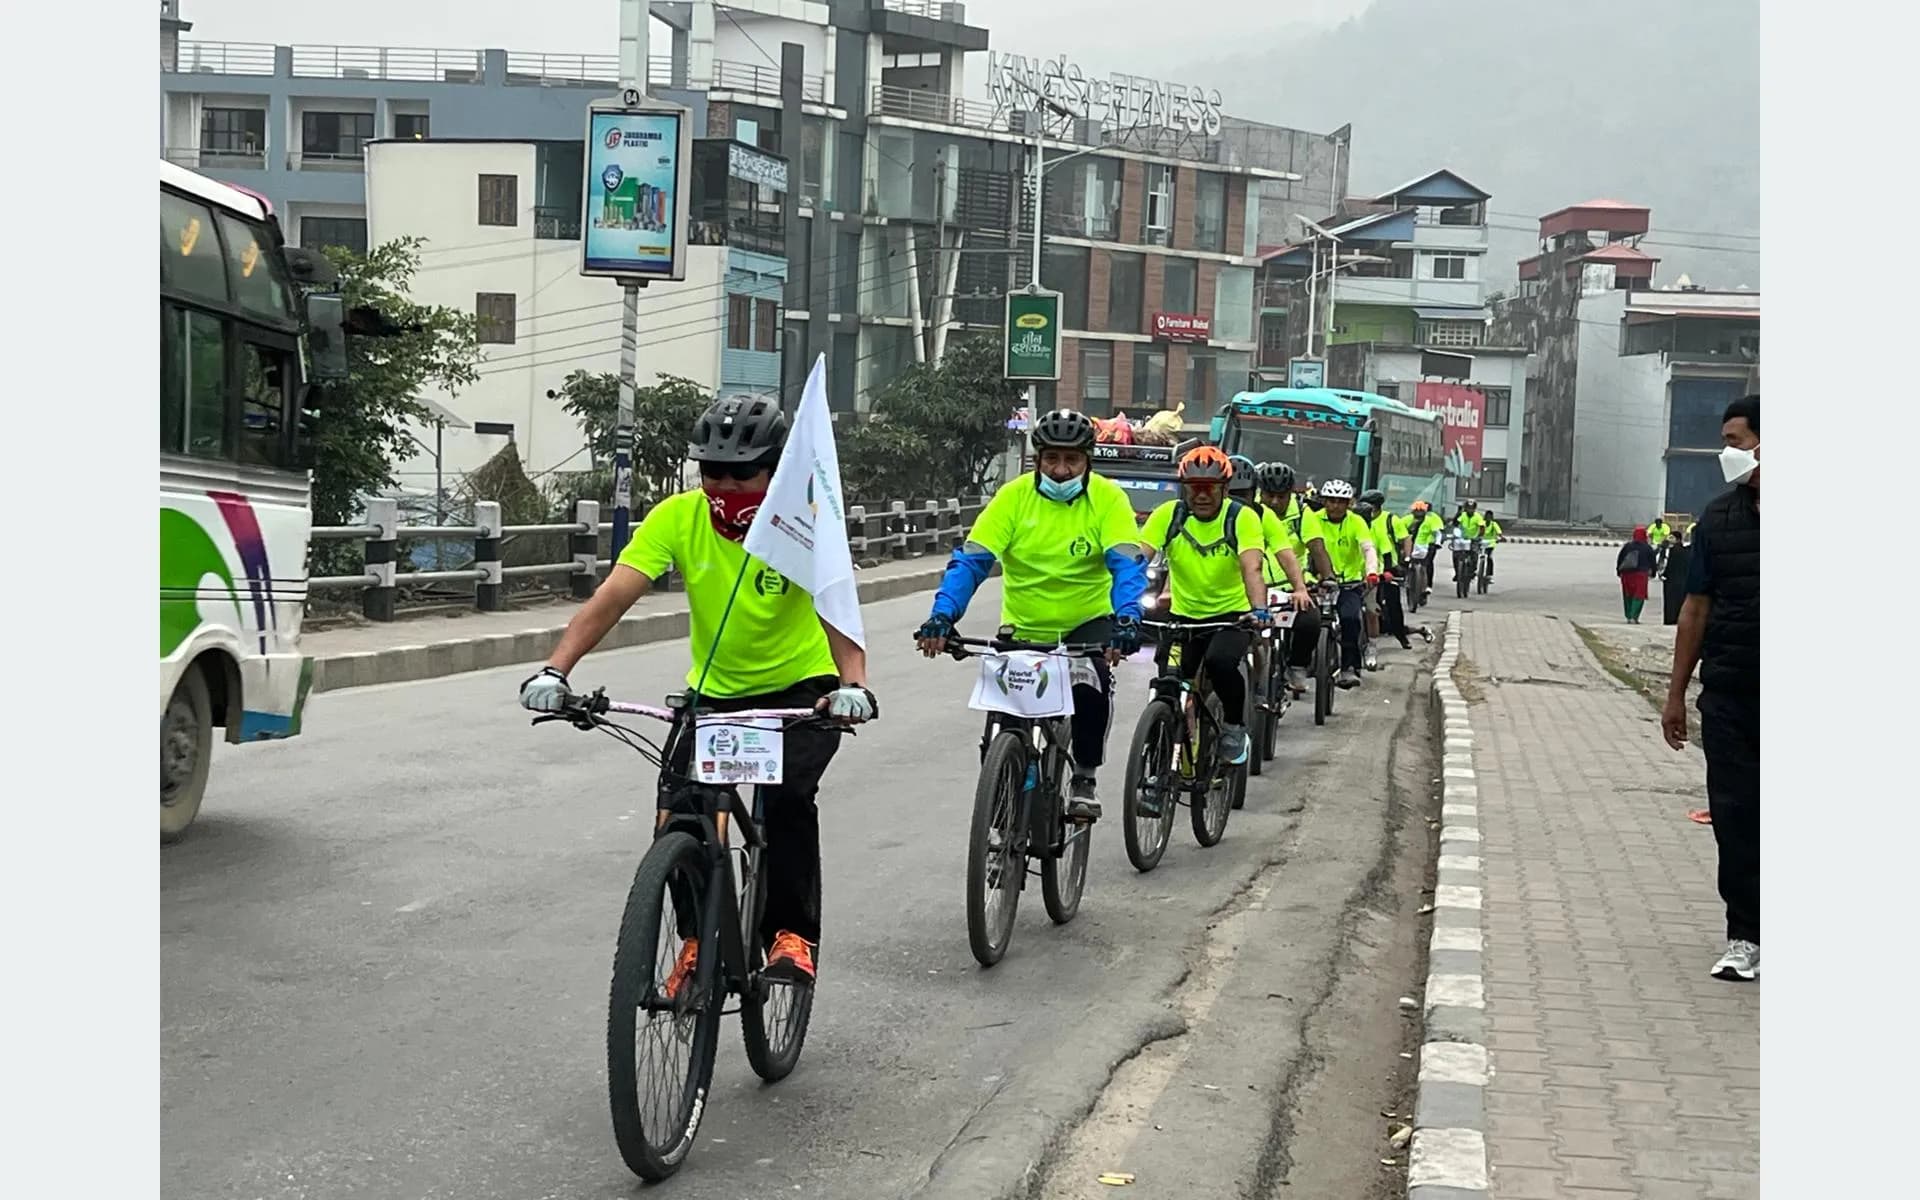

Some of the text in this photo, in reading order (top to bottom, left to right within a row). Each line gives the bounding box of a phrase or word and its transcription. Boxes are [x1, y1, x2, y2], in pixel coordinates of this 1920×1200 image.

[1110, 72, 1222, 136] FITNESS
[1008, 677, 1036, 685] Kidney
[1009, 683, 1024, 691] Day
